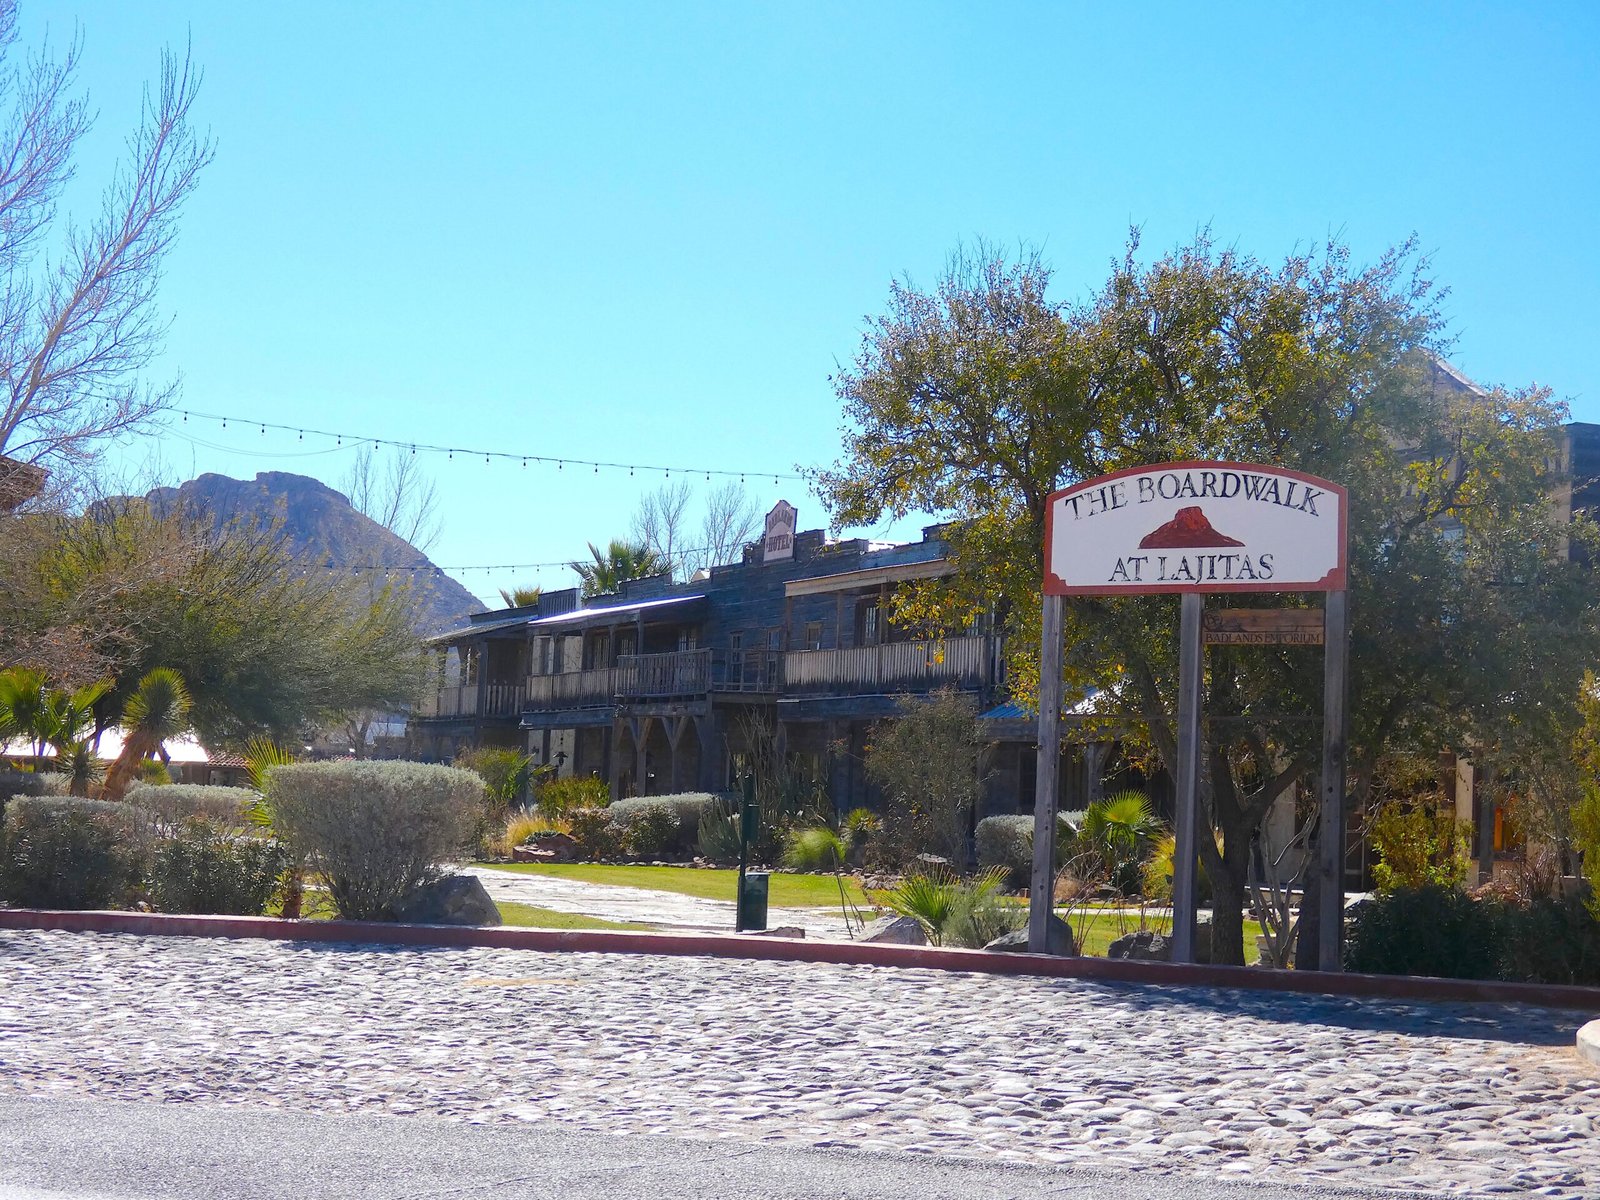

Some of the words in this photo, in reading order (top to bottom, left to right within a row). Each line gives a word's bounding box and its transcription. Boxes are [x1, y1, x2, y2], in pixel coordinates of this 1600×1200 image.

[1065, 481, 1128, 520] THE
[1136, 471, 1325, 517] BOARDWALK
[1108, 556, 1149, 582] AT
[1157, 553, 1275, 585] LAJITAS
[1206, 633, 1263, 643] BADLANDS
[1264, 633, 1321, 643] EMPORIUM
